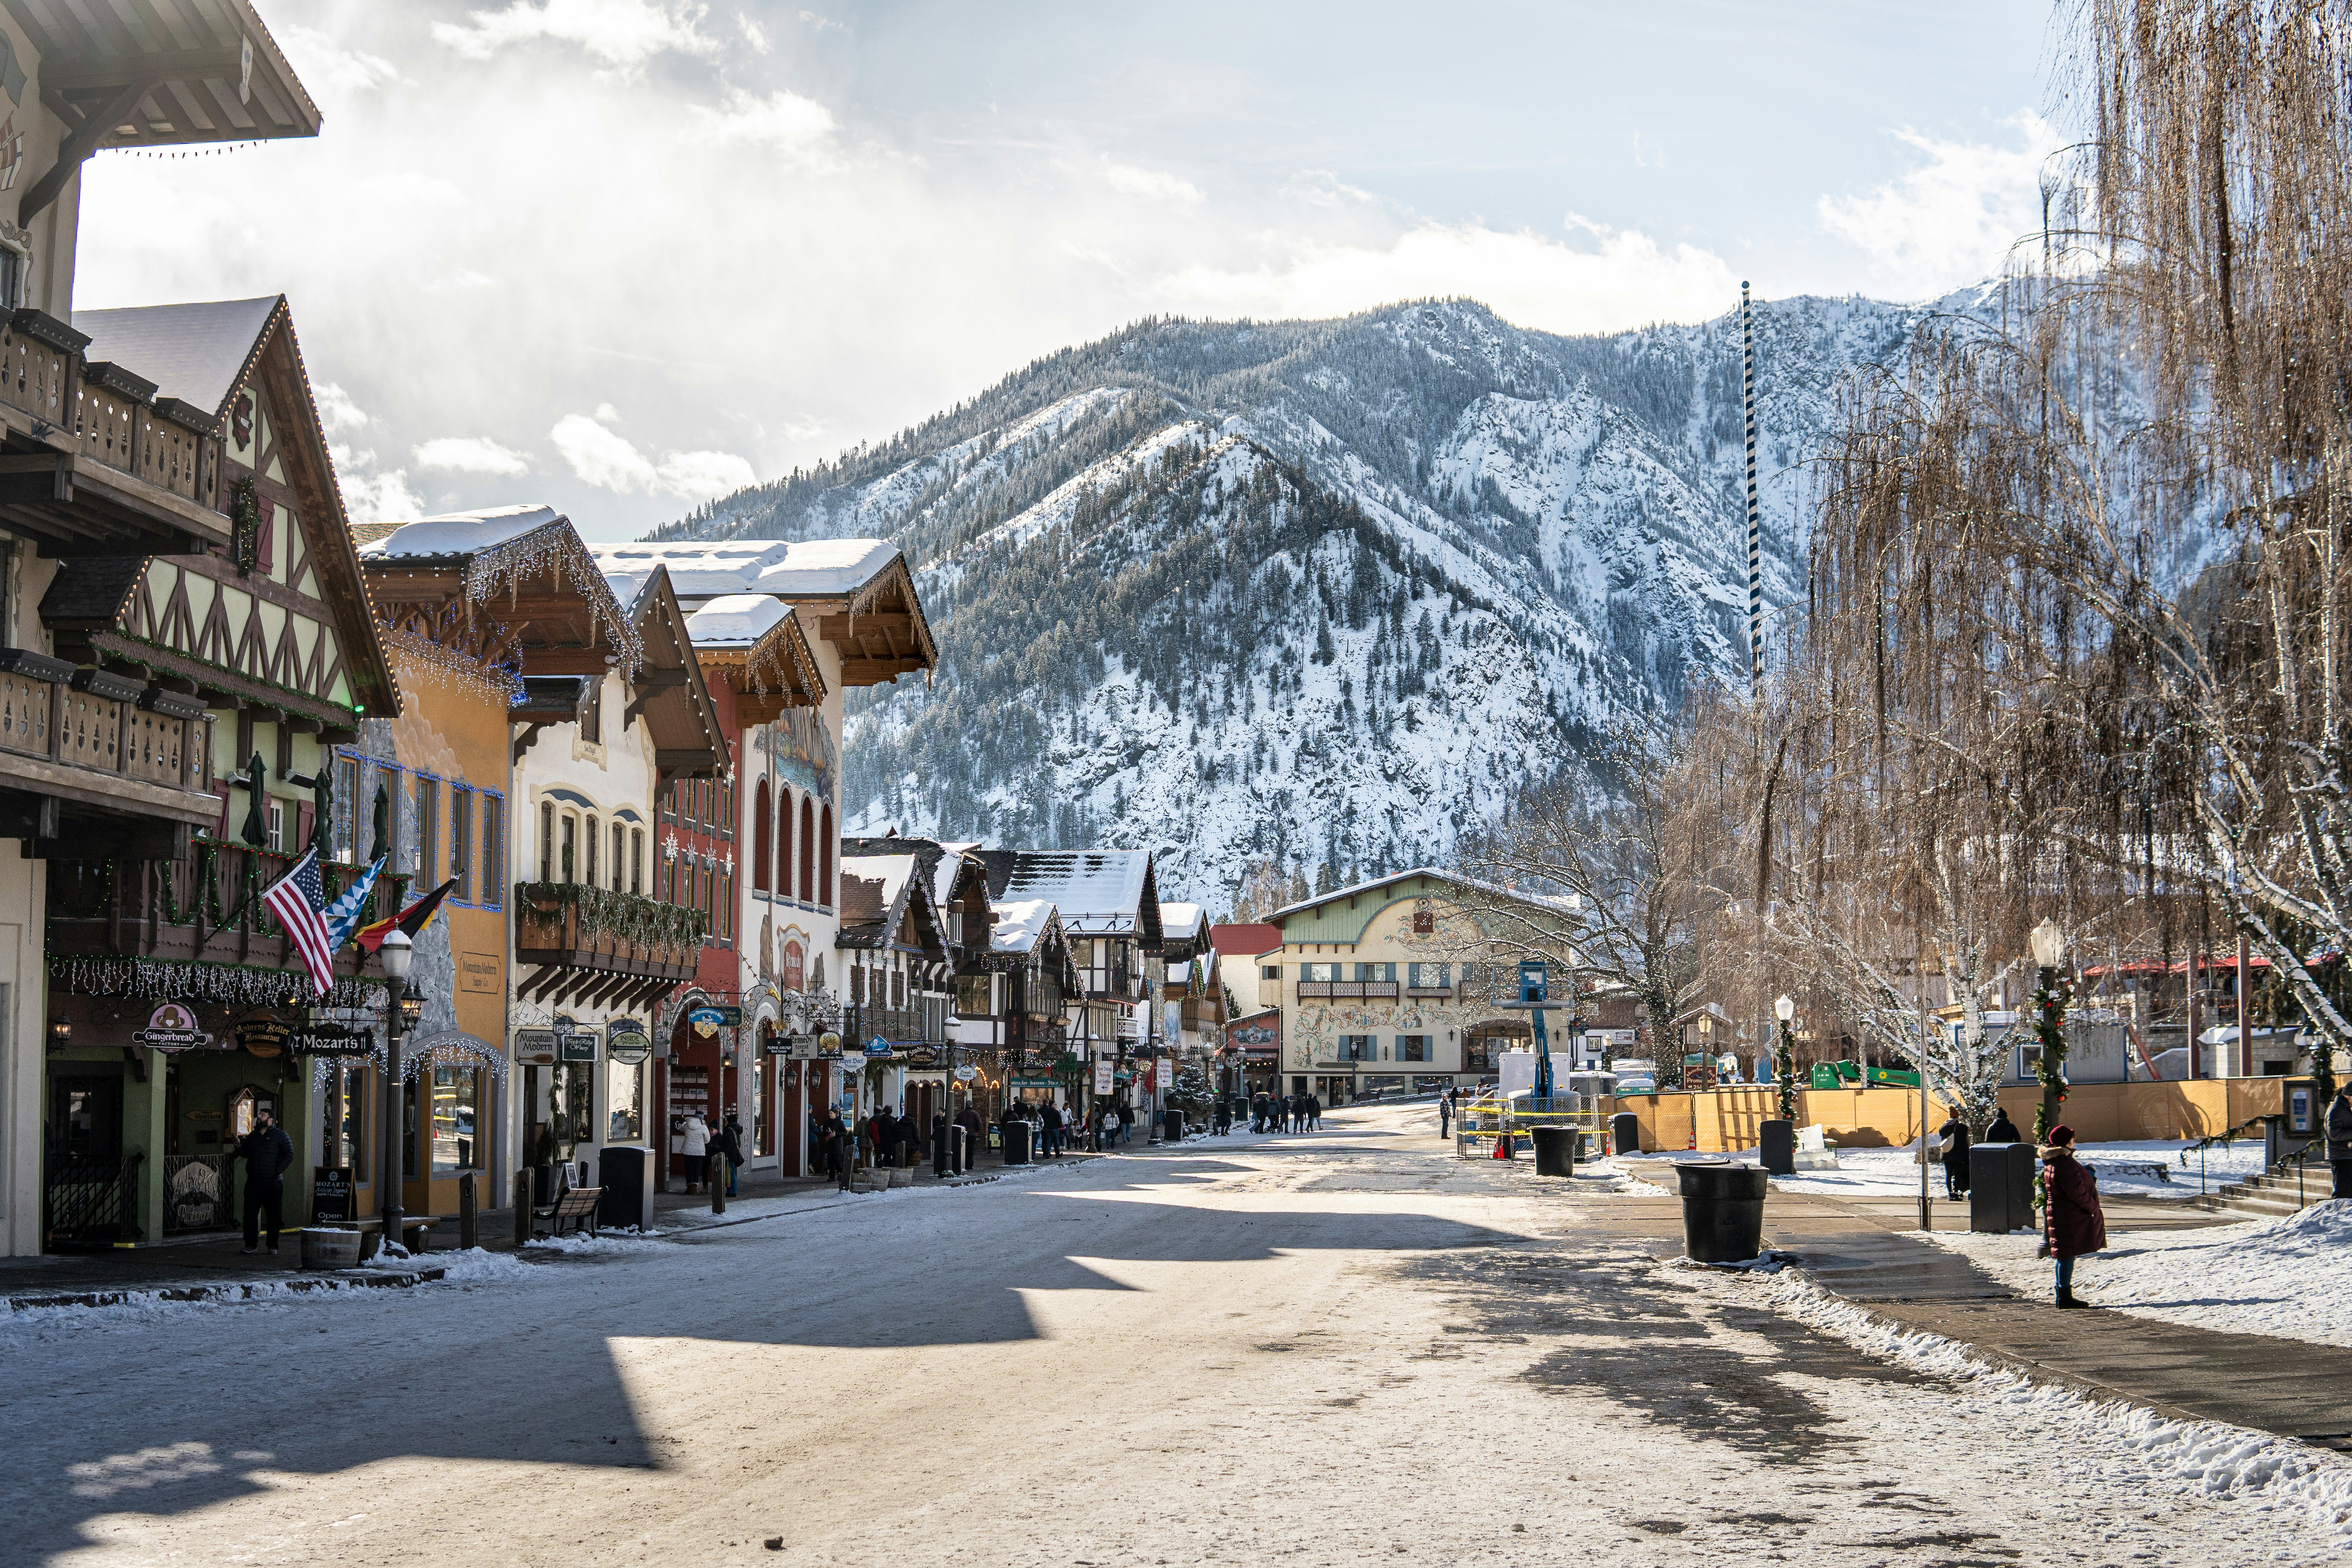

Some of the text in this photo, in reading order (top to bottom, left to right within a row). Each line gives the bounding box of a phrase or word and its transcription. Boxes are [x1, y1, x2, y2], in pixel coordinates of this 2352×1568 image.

[462, 960, 497, 975] Mountain Modern
[786, 952, 801, 973] Remedy
[237, 1022, 290, 1035] Andreas Keller
[145, 1032, 194, 1042] Gingerbread
[245, 1033, 280, 1042] Restaurant
[519, 1034, 553, 1042] Mountain
[790, 1035, 813, 1045] Remedy
[303, 1035, 358, 1051] Mozart's
[523, 1043, 553, 1051] Modern
[617, 1051, 642, 1061] Boudreaux
[909, 1046, 937, 1056] Studio 1890
[1686, 1067, 1703, 1077] Waterfro
[200, 1132, 216, 1141] OPEN
[173, 1170, 200, 1200] Andreas
[177, 1205, 210, 1222] Restaurant
